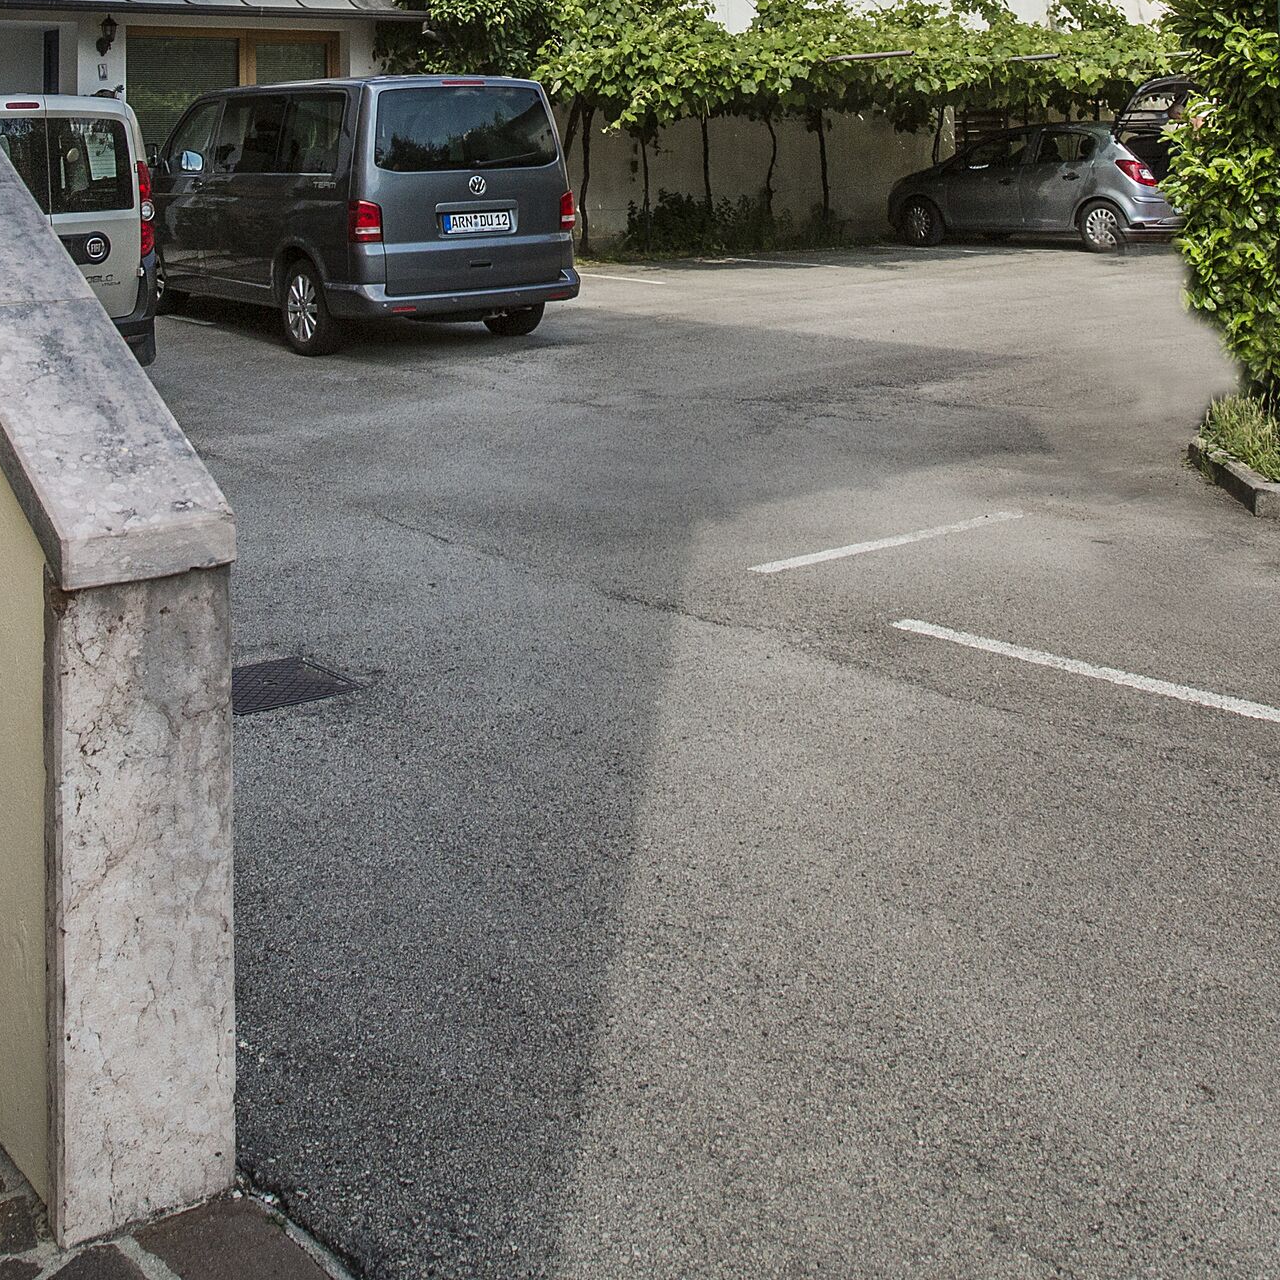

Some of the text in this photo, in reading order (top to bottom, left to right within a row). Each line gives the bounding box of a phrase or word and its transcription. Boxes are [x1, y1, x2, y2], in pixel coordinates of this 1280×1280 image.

[313, 181, 336, 189] TEAM
[452, 213, 508, 228] ARN DU 12
[86, 274, 114, 284] OBLO
